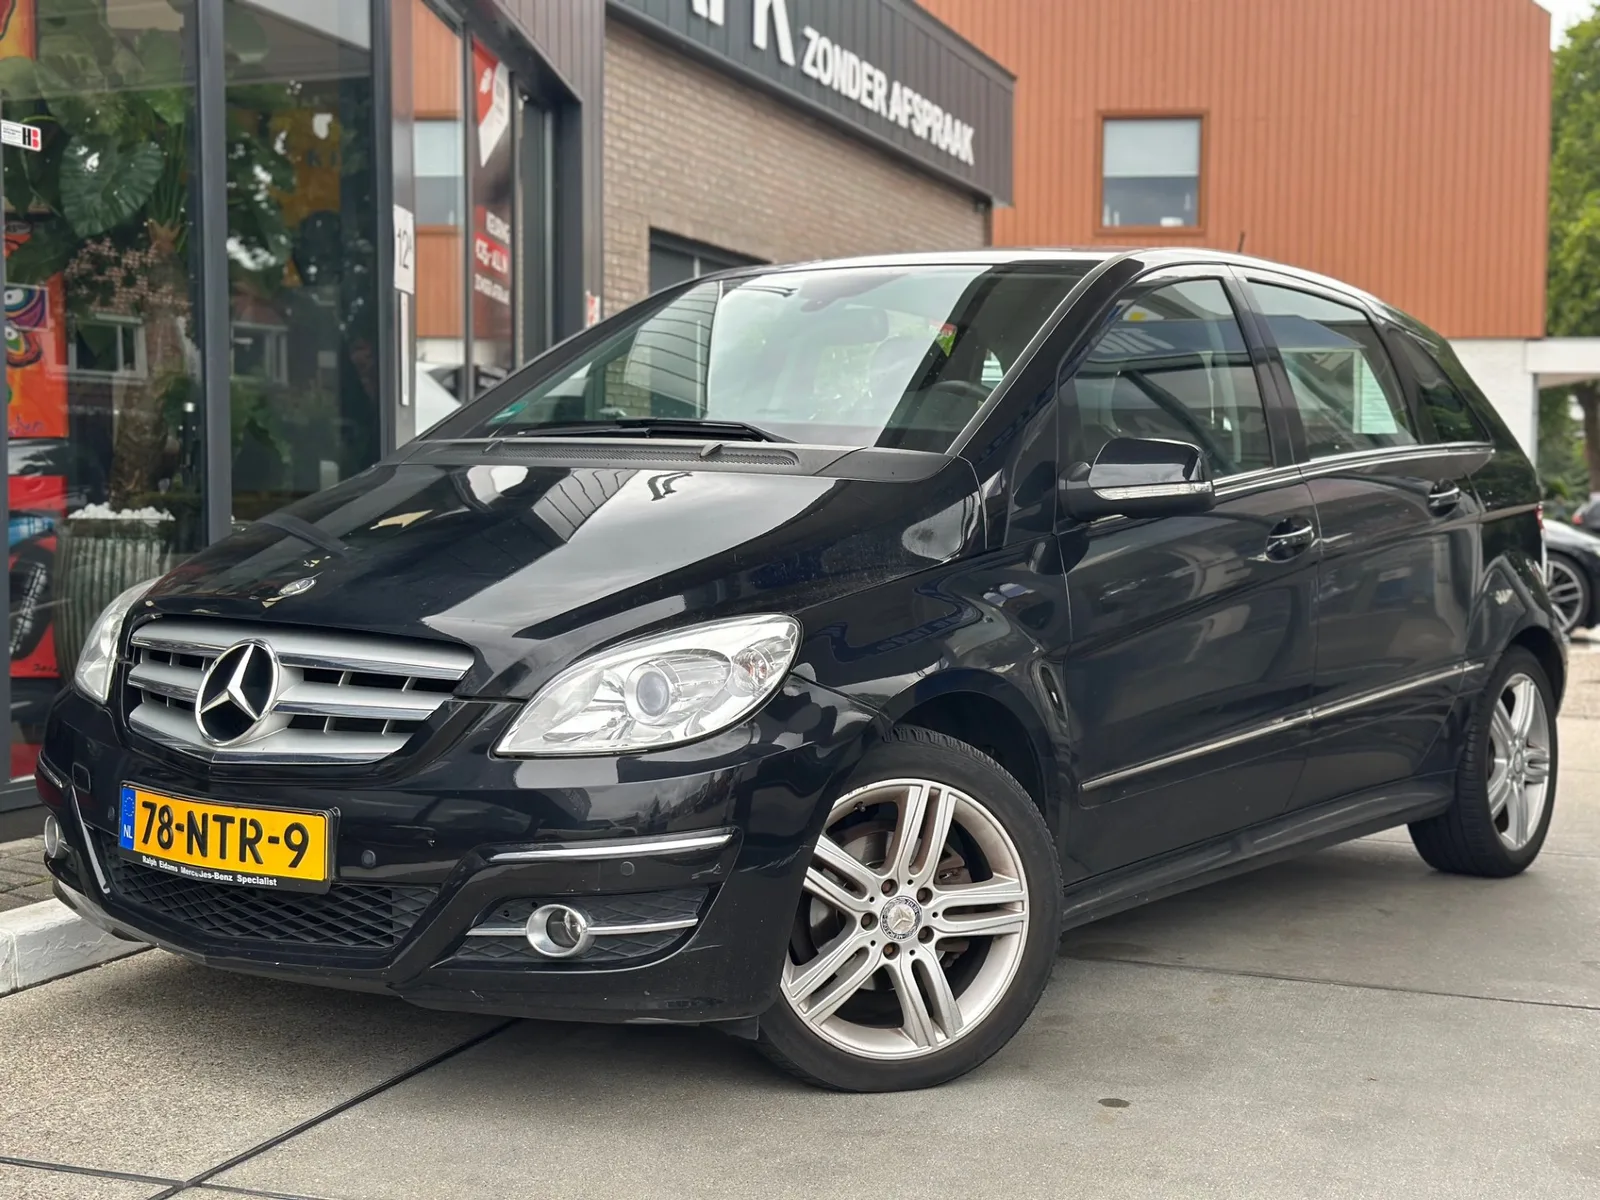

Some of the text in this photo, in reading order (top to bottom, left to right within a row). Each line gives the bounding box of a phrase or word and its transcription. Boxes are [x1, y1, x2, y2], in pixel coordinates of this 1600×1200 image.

[801, 25, 888, 118] ZONDER
[888, 80, 975, 166] AFSPRAAK
[123, 824, 133, 840] NL
[141, 800, 310, 869] 78-NTR-9
[142, 855, 158, 867] Ralph
[237, 874, 277, 887] Specialist
